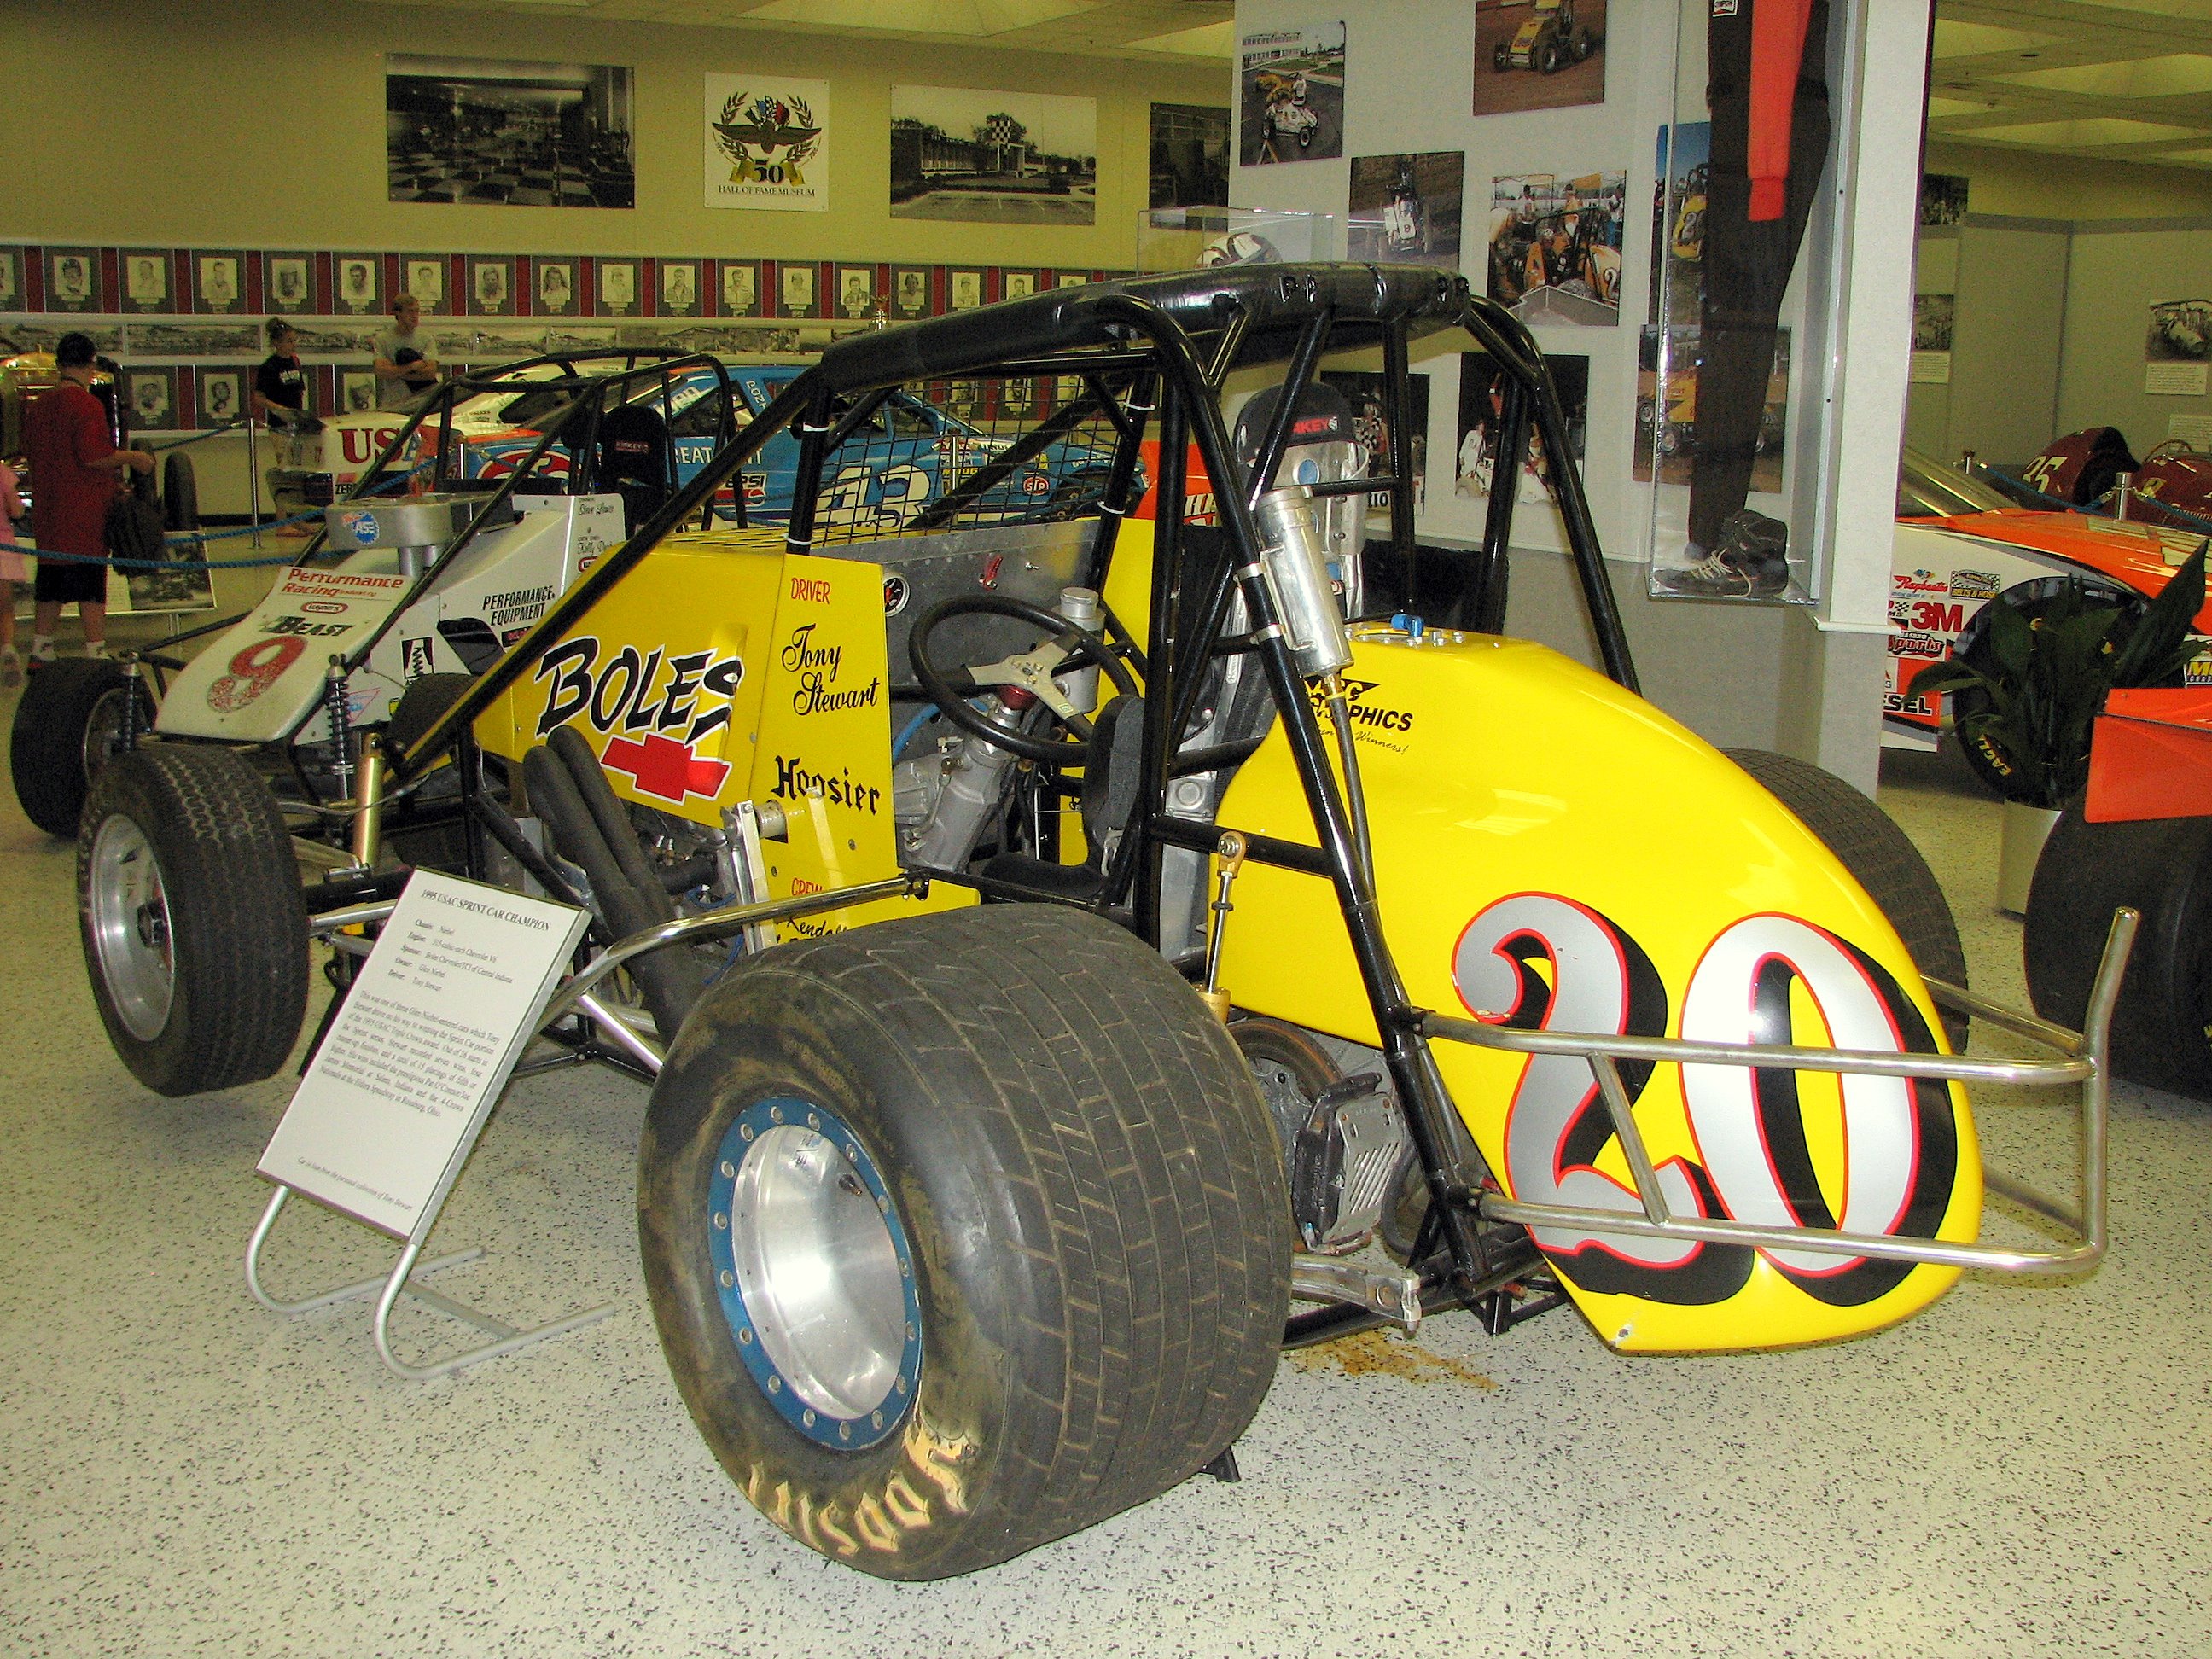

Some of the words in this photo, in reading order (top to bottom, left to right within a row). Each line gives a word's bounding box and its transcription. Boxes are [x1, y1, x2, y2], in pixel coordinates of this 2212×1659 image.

[719, 185, 741, 194] HALL
[742, 186, 752, 195] OF
[755, 186, 777, 195] FAME
[778, 187, 816, 197] MUSEUM
[281, 582, 341, 597] Racing
[288, 568, 405, 589] Performance
[790, 577, 831, 604] DRIVER
[482, 585, 554, 611] PERFORMANCE
[490, 602, 546, 626] EQUIPMENT
[1910, 601, 1963, 633] 3M
[782, 624, 843, 682] Tony
[207, 636, 308, 713] 9
[535, 637, 743, 746] BOLES
[793, 672, 881, 717] Stewart
[771, 755, 882, 817] Hoosier
[437, 893, 458, 906] USAC
[457, 899, 487, 914] SPRINT
[486, 905, 504, 918] CAR
[504, 911, 550, 931] CHAMPION
[1451, 891, 1958, 1307] 20
